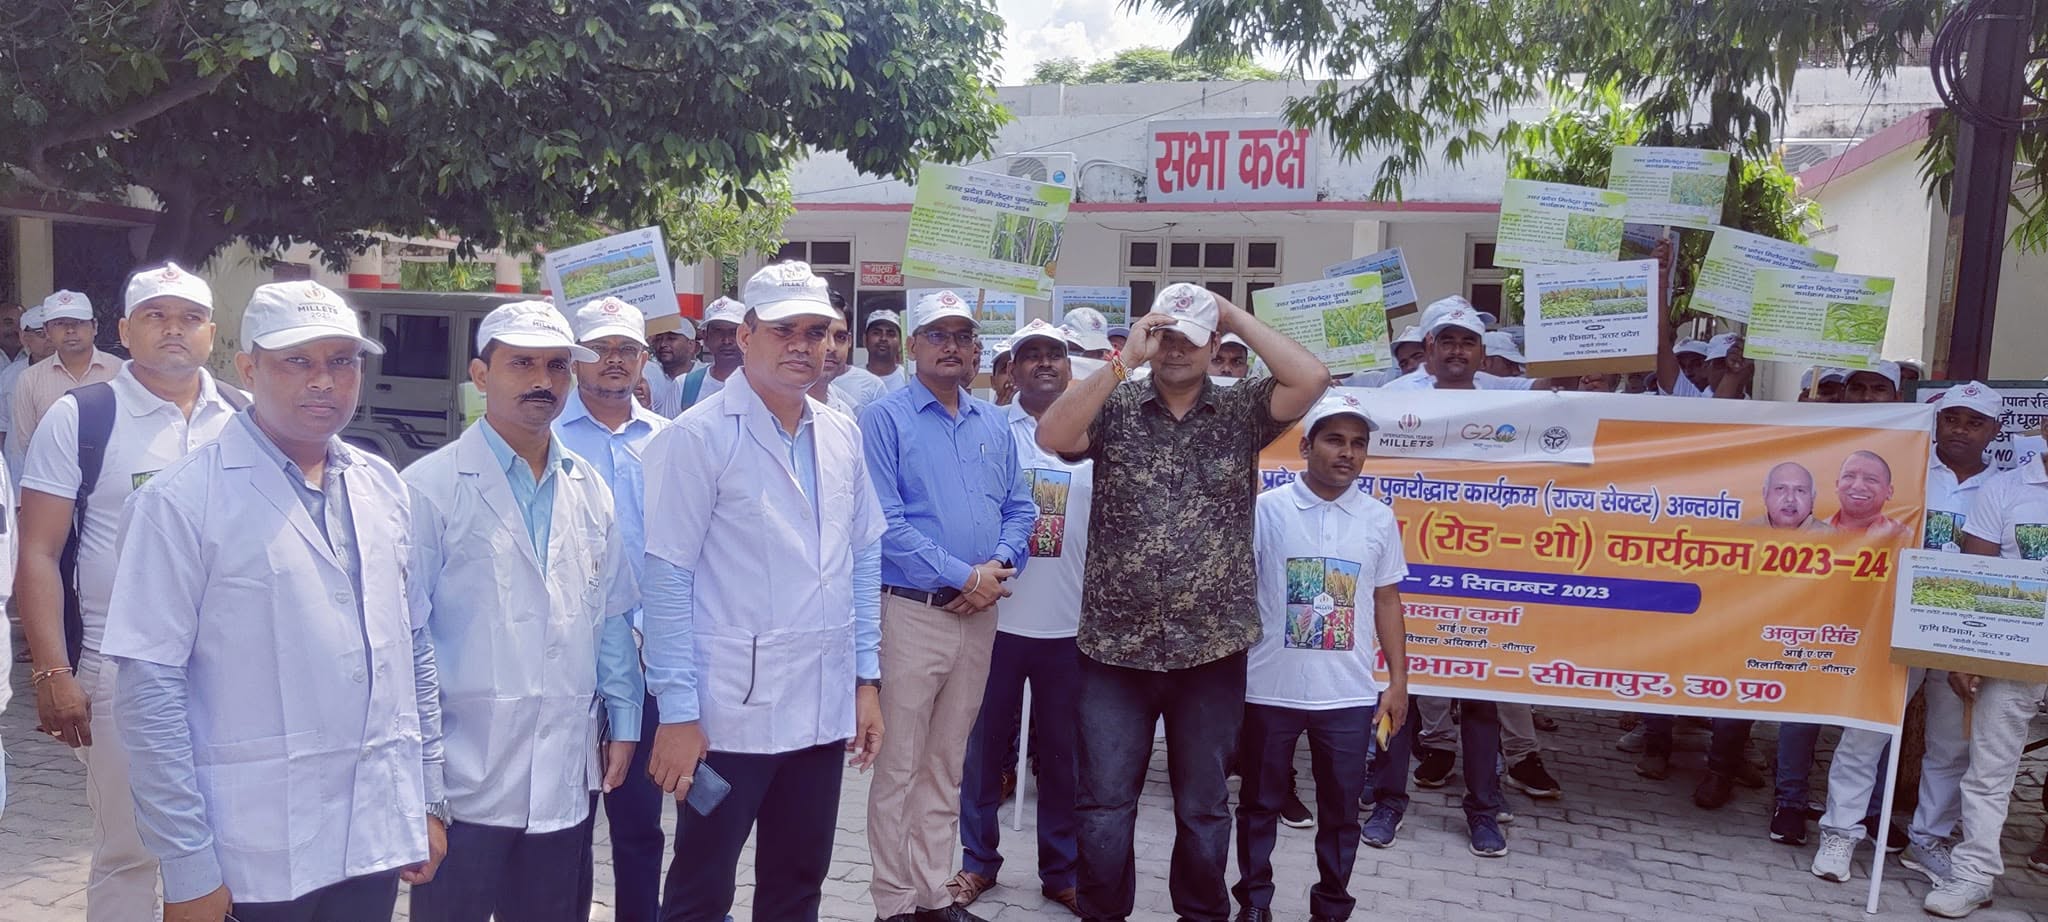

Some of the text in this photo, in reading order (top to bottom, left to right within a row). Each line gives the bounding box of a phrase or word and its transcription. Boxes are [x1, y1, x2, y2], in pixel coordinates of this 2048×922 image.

[1155, 129, 1309, 193] सभा कक्ष
[297, 305, 338, 315] MILLETS
[1379, 438, 1434, 448] MILLETS
[1461, 423, 1516, 443] G20
[1379, 473, 1460, 504] पुनरोद्धार
[1463, 477, 1538, 508] कार्यक्रम
[1544, 481, 1596, 516] (राज्य
[1600, 485, 1659, 522] सेक्टर)
[1666, 491, 1741, 519] अन्तर्गत
[1419, 511, 1494, 560] (रोड
[1533, 521, 1593, 571] शो)
[1607, 529, 1754, 571] कार्यक्रम
[1429, 575, 1454, 588] 25
[1461, 573, 1556, 596] सितम्बर
[1561, 584, 1611, 600] 2023
[1468, 606, 1521, 624] वर्मा
[1763, 626, 1858, 646] अनुज सिंह
[1919, 623, 1940, 634] कृषि
[1442, 637, 1488, 649] अधिकारी
[1502, 642, 1536, 654] सीतापुर
[1747, 659, 1808, 672] जिलाधिकारी
[1821, 664, 1857, 676] सीतापुर
[1532, 662, 1674, 697] सीतापुर,
